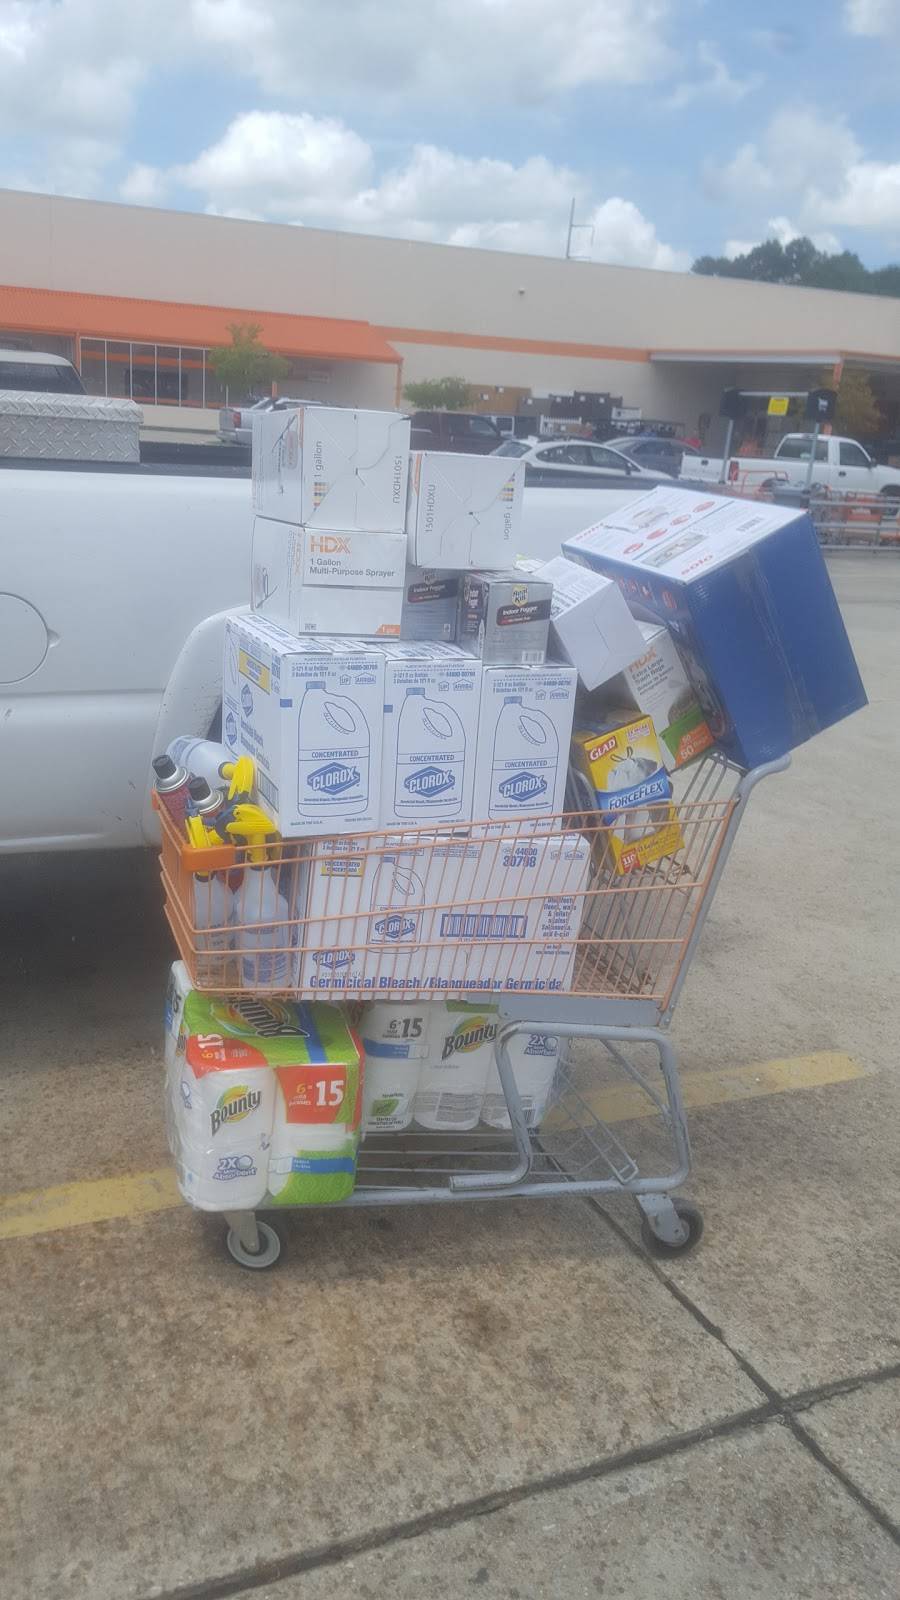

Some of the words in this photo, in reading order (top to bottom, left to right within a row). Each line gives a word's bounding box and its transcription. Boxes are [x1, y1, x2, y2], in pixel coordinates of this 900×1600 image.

[314, 441, 323, 472] gallon
[393, 455, 403, 505] 1501HDXU
[425, 483, 436, 533] 1501HDXU
[503, 512, 512, 541] gallon
[310, 535, 351, 554] HDX
[309, 566, 364, 577] Multi-Purpose
[365, 568, 395, 579] Sprayer
[310, 558, 314, 566] 1
[317, 558, 342, 567] Gallon
[502, 608, 519, 617] Indoor
[519, 605, 538, 616] Fogger
[312, 750, 359, 758] CONCENTRATED
[409, 754, 455, 762] CONCENTRATED
[589, 738, 616, 761] GLAD
[680, 744, 695, 760] 50
[504, 760, 548, 769] CONCENTRATED
[312, 766, 355, 791] CLOROX
[409, 770, 452, 793] CLOROX
[503, 775, 545, 798] CLOROX
[379, 977, 420, 988] Bleach
[390, 1019, 398, 1030] 6
[402, 1017, 424, 1038] 15
[198, 1033, 224, 1049] 15
[442, 1022, 498, 1061] Bounty
[529, 1034, 546, 1046] 2X
[296, 1083, 306, 1094] 6
[316, 1080, 345, 1107] 15
[210, 1088, 262, 1137] Bounty
[218, 1157, 238, 1171] 2X
